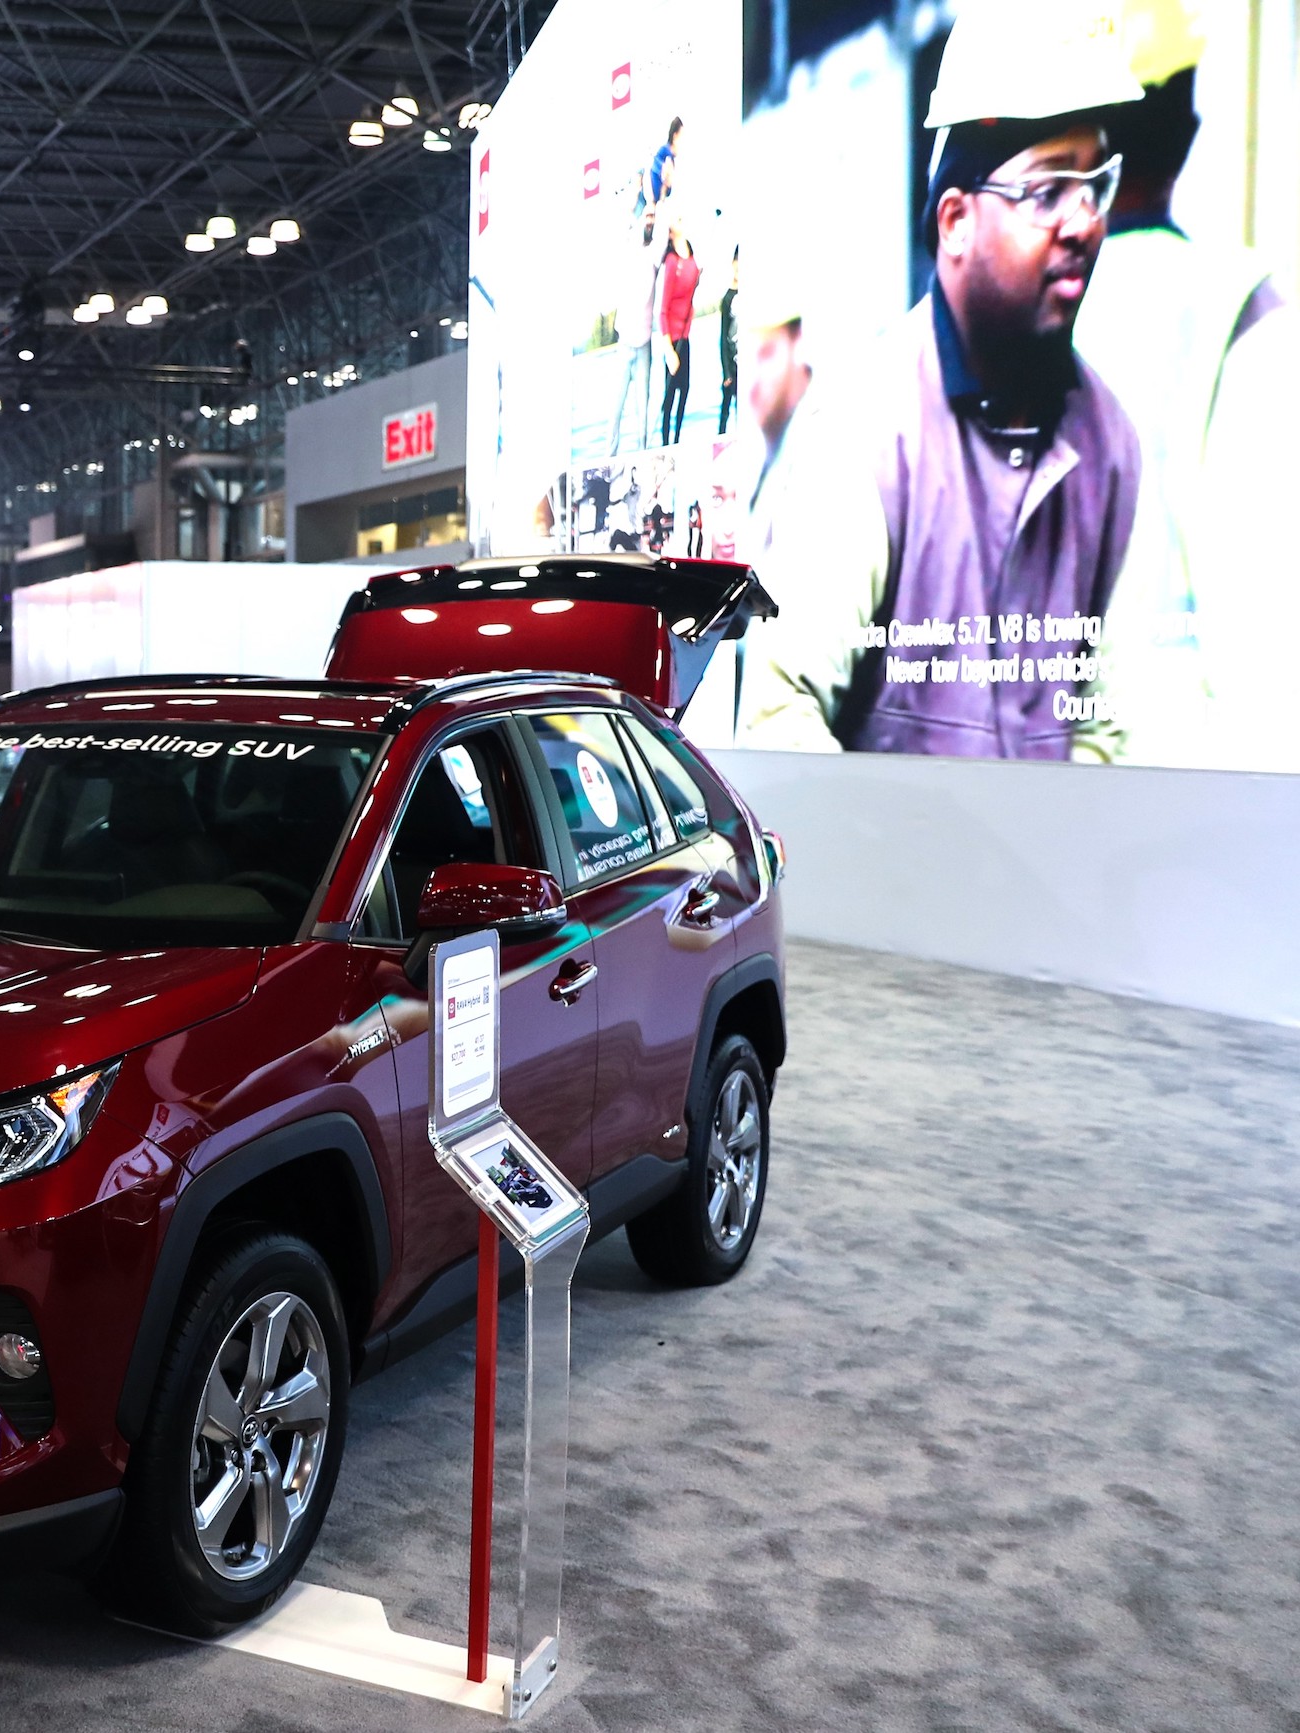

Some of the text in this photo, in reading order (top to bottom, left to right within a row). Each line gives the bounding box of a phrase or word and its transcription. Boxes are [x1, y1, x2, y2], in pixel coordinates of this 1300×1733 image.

[386, 410, 433, 463] Exit
[888, 617, 956, 647] CrewMax
[958, 615, 996, 645] 5.7L
[998, 613, 1023, 644] V8
[1026, 612, 1041, 643] is
[1043, 610, 1102, 647] towing
[886, 655, 929, 684] Never
[931, 655, 959, 683] tow
[961, 653, 1019, 688] beyond
[1022, 658, 1034, 682] a
[20, 733, 223, 758] best-selling
[228, 739, 315, 761] SUV
